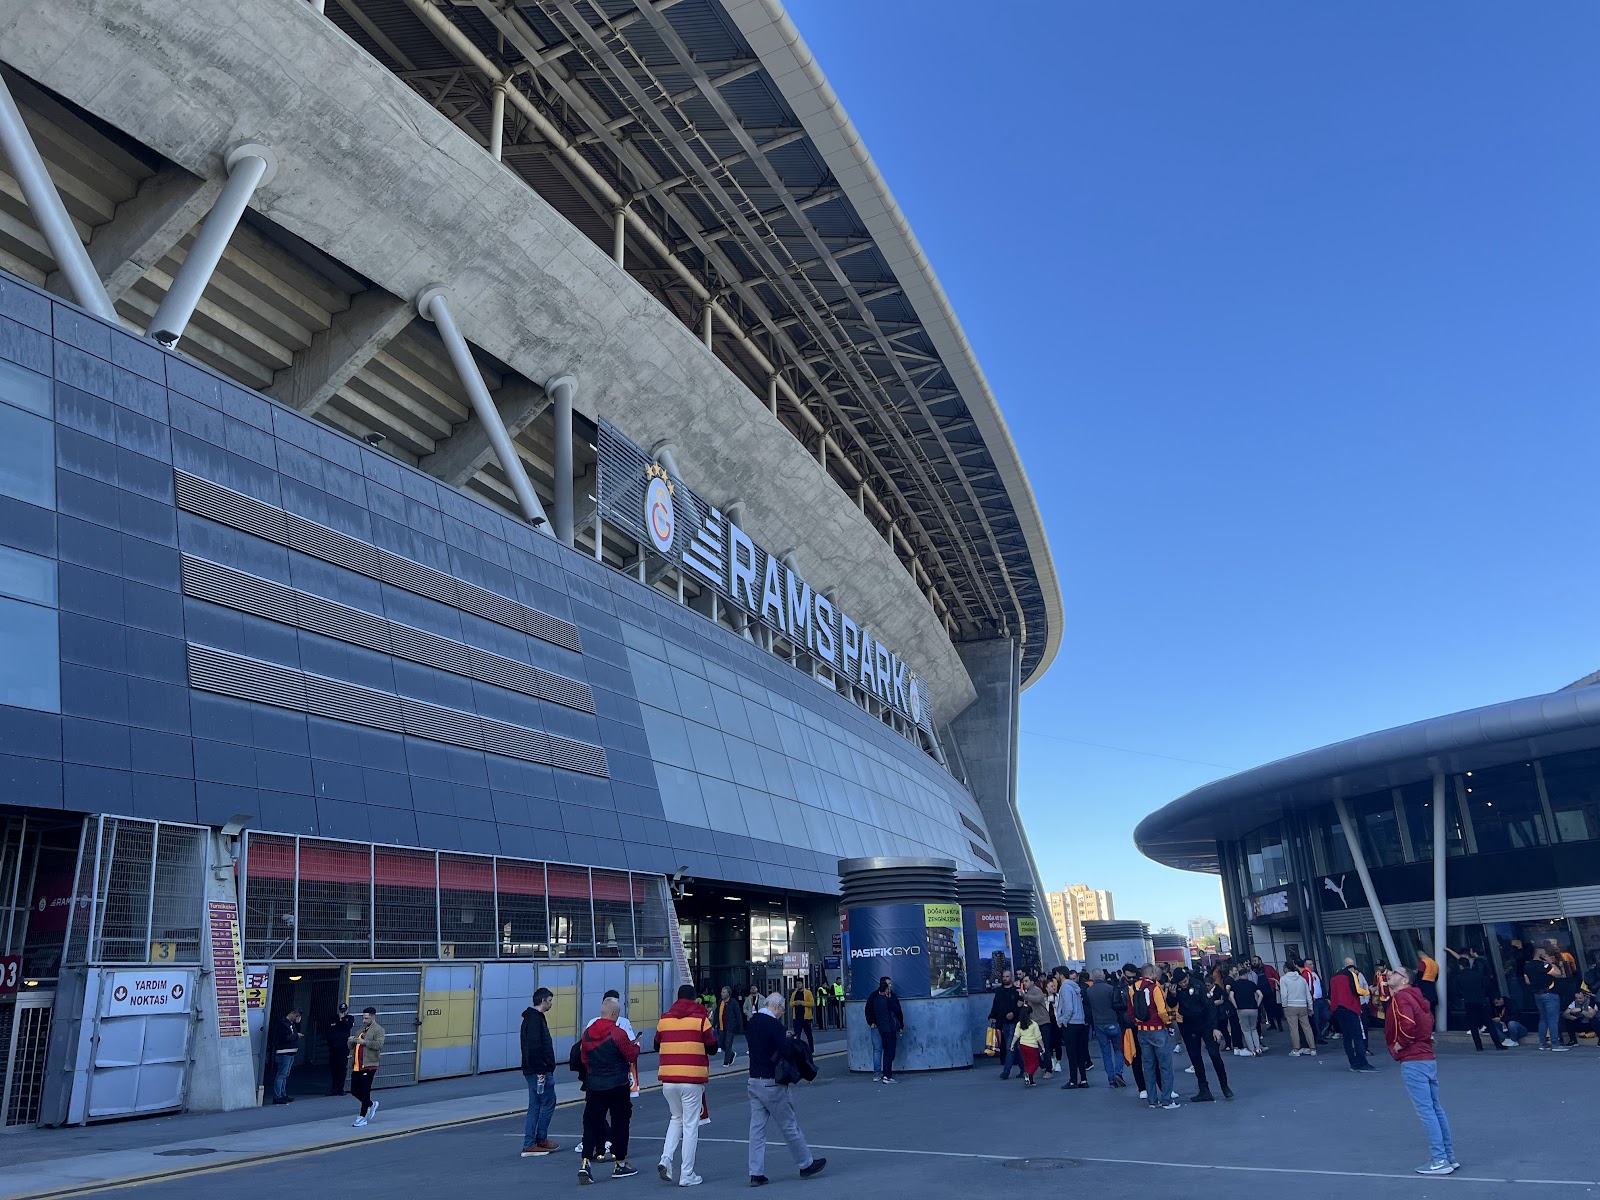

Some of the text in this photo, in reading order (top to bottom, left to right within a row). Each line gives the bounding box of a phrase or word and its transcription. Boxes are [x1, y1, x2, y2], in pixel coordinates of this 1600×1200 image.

[729, 521, 909, 715] RAMS PARK
[158, 943, 169, 959] 3
[443, 945, 450, 956] 4
[551, 945, 557, 956] 5
[1100, 952, 1120, 962] HDI
[135, 980, 168, 990] YARDIM
[130, 995, 168, 1006] NOKTASI
